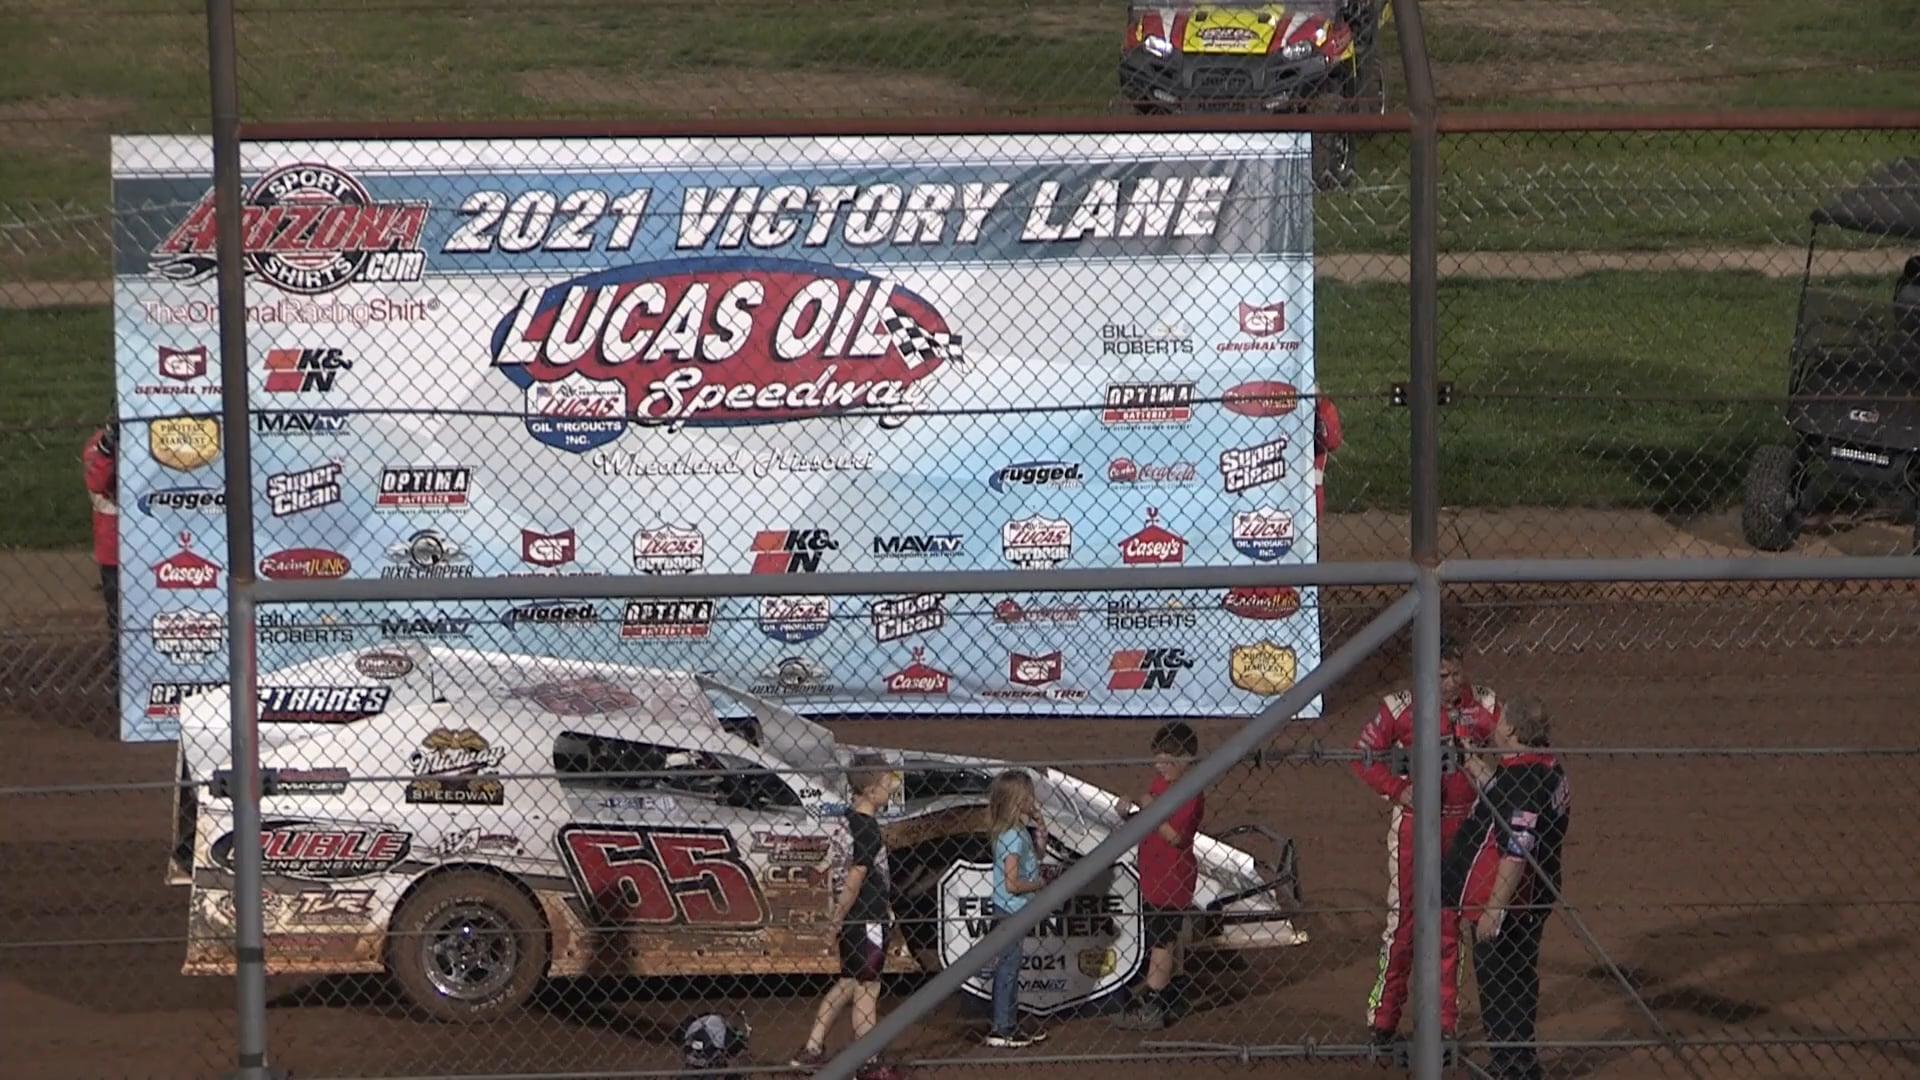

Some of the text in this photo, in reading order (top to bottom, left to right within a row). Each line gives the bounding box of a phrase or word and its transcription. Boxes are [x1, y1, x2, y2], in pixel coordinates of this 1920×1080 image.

[268, 170, 349, 197] SPORT
[441, 176, 1232, 253] 2021 VICTORY LANE
[264, 258, 355, 288] SHIRTS
[490, 278, 901, 367] LUCAS OIL
[1102, 324, 1144, 339] BILL
[1102, 339, 1194, 355] ROBERTS
[1216, 341, 1273, 352] GENERAL
[135, 386, 223, 395] GENERAL TIR
[634, 364, 939, 432] Speedway
[1108, 386, 1189, 404] OPTIMA
[539, 396, 620, 416] LUCAS
[531, 420, 623, 433] OIL PRODUCTS
[564, 434, 591, 446] INC.
[592, 448, 743, 478] Wheatland
[1221, 439, 1285, 474] Super
[268, 463, 341, 494] Super
[382, 471, 467, 491] OPTIMA
[1225, 459, 1284, 492] Clean
[273, 484, 339, 516] Clean
[1011, 529, 1066, 545] LUCAS
[1241, 520, 1291, 538] LUCAS
[641, 538, 699, 554] LUCAS
[1004, 547, 1069, 561] OUTDOOR
[1126, 538, 1181, 560] Casey's
[635, 556, 702, 571] OUTDOOR
[159, 563, 214, 586] Casey's
[877, 611, 942, 641] Clean
[1107, 614, 1197, 630] ROBERTS
[260, 627, 354, 645] ROBERTS
[891, 673, 945, 692] Casey's
[408, 745, 507, 776] Midway
[412, 790, 497, 801] SPEEDWAY
[227, 831, 408, 861] UBLE
[308, 860, 389, 870] ENGINES
[959, 895, 1125, 917] FEURE
[965, 916, 1116, 938] WNER
[1020, 954, 1067, 970] 2021
